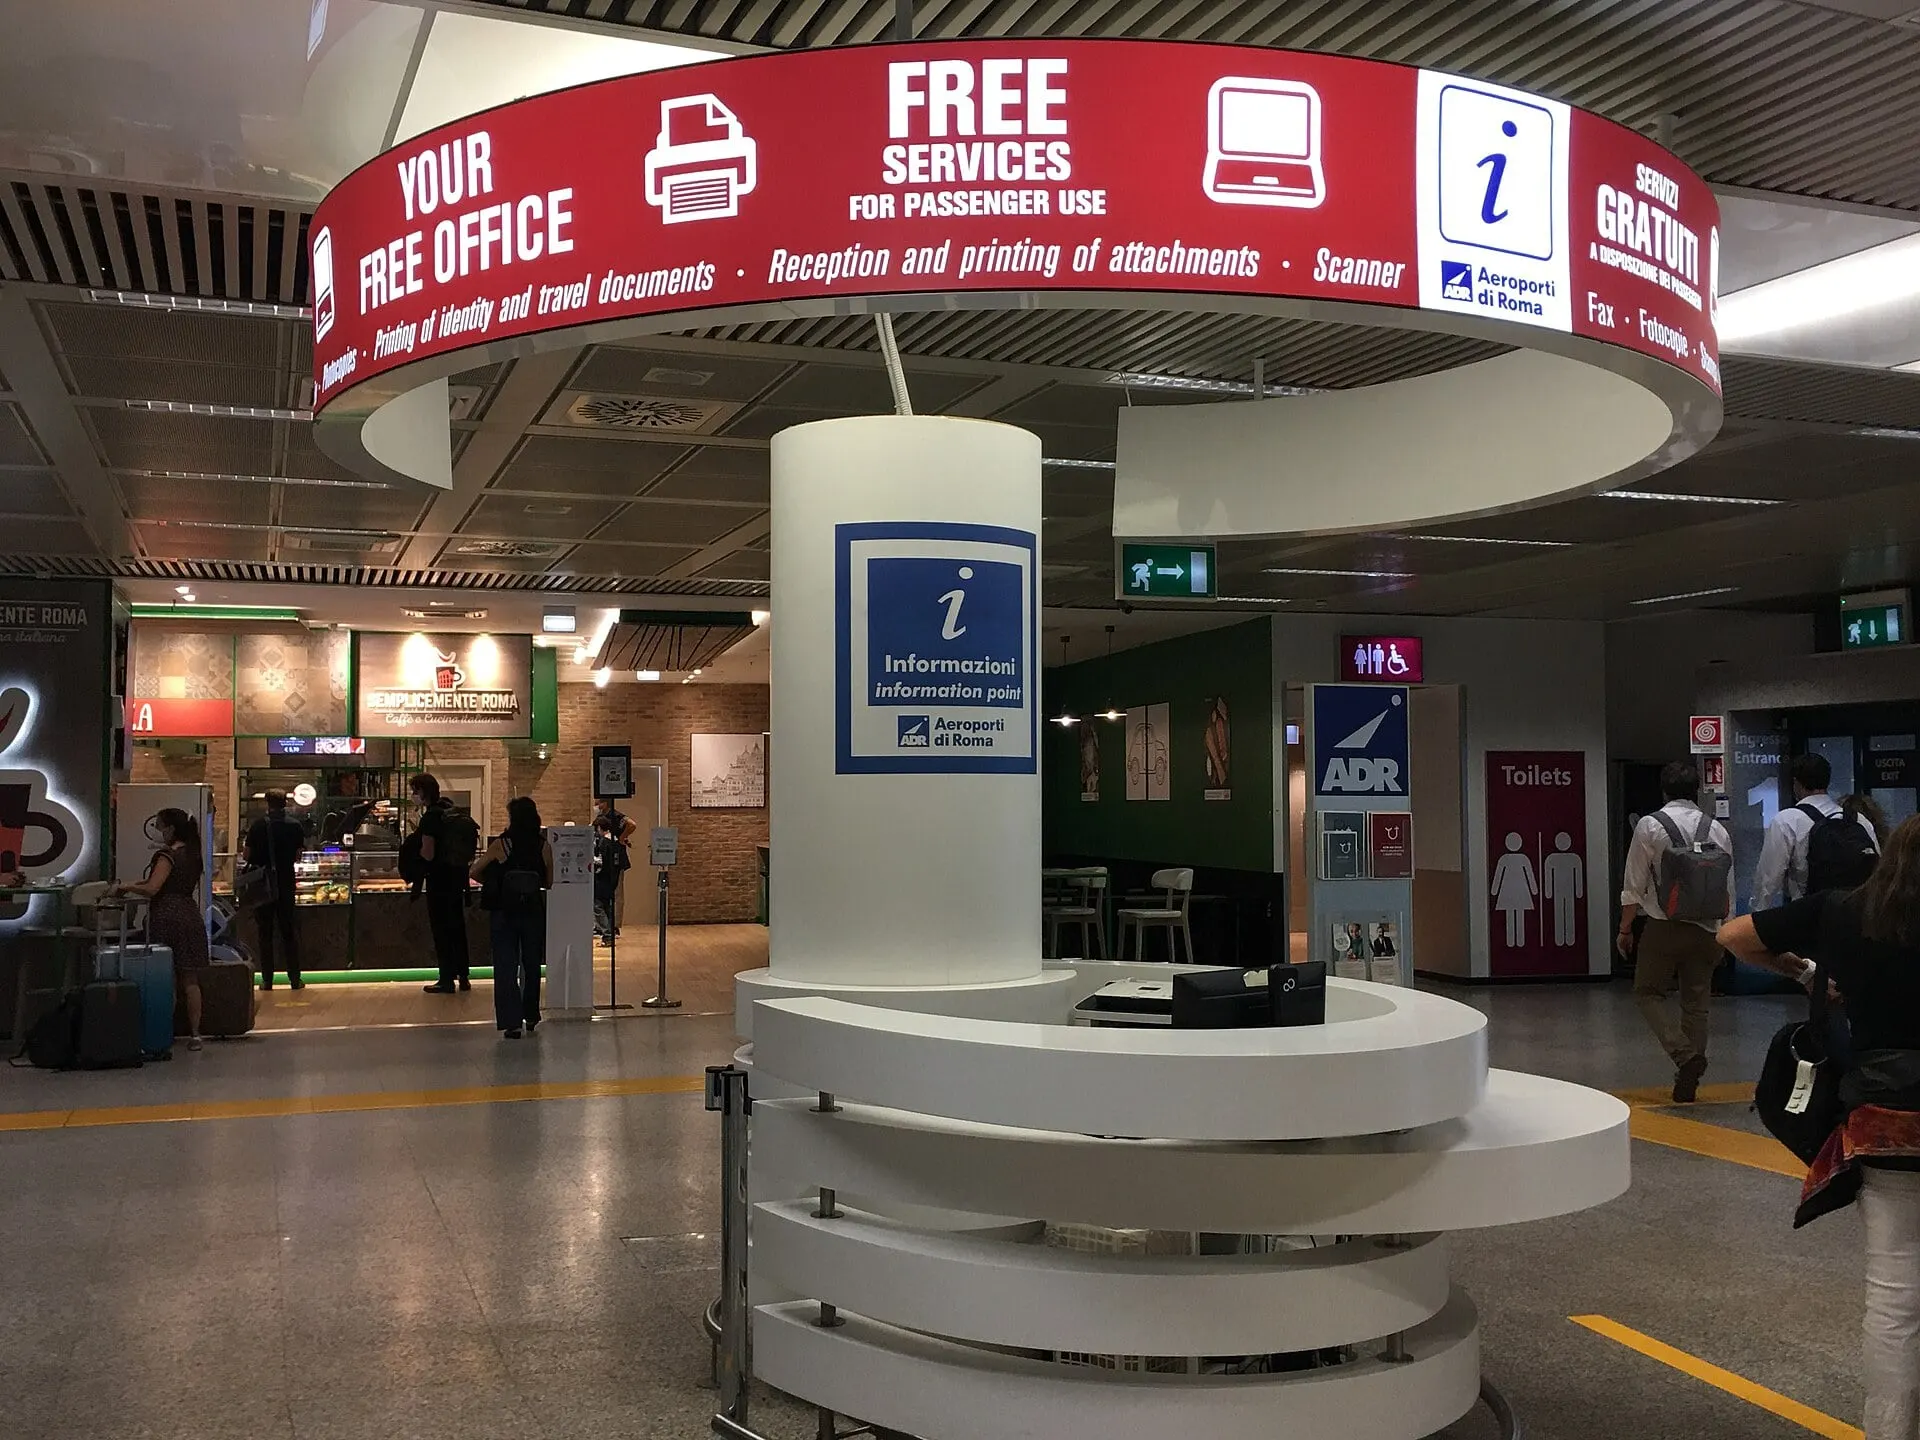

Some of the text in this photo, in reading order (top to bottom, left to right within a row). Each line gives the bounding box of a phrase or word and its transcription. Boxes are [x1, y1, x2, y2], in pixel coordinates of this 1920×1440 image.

[888, 58, 1068, 139] FREE
[398, 130, 493, 220] YOUR
[882, 141, 1072, 185] SERVICES
[1635, 162, 1679, 212] SERVIZI
[849, 189, 1107, 221] FOR PASSENGER USE
[1596, 183, 1699, 286] GRATUITI
[360, 187, 574, 315] FREE OFFICE
[1590, 241, 1598, 260] A
[1444, 282, 1473, 302] ADR
[1478, 266, 1555, 297] Aeroporti
[373, 320, 417, 360] Printing
[421, 309, 436, 343] of
[438, 297, 493, 339] identity
[499, 287, 532, 320] and
[537, 273, 592, 311] travel
[598, 260, 716, 305] documents
[767, 246, 890, 285] Reception
[901, 239, 948, 275] and
[958, 237, 1061, 280] printing
[1072, 237, 1102, 273] of
[1108, 239, 1261, 278] attachments
[1313, 247, 1406, 289] Scanner
[1478, 289, 1543, 316] di Roma
[1587, 291, 1615, 329] Fax
[1639, 307, 1689, 359] Fotocopie
[42, 607, 88, 626] ROMA
[884, 653, 1016, 676] Informazioni
[366, 692, 519, 709] SEMPLICEMENTE ROMA
[874, 681, 1022, 702] information point
[424, 713, 459, 724] Cucina
[933, 716, 1005, 734] Aeroporti
[899, 734, 928, 746] ADR
[933, 733, 994, 748] di Roma
[1320, 757, 1403, 792] ADR
[1501, 764, 1573, 787] Toilets
[1748, 777, 1780, 830] 1
